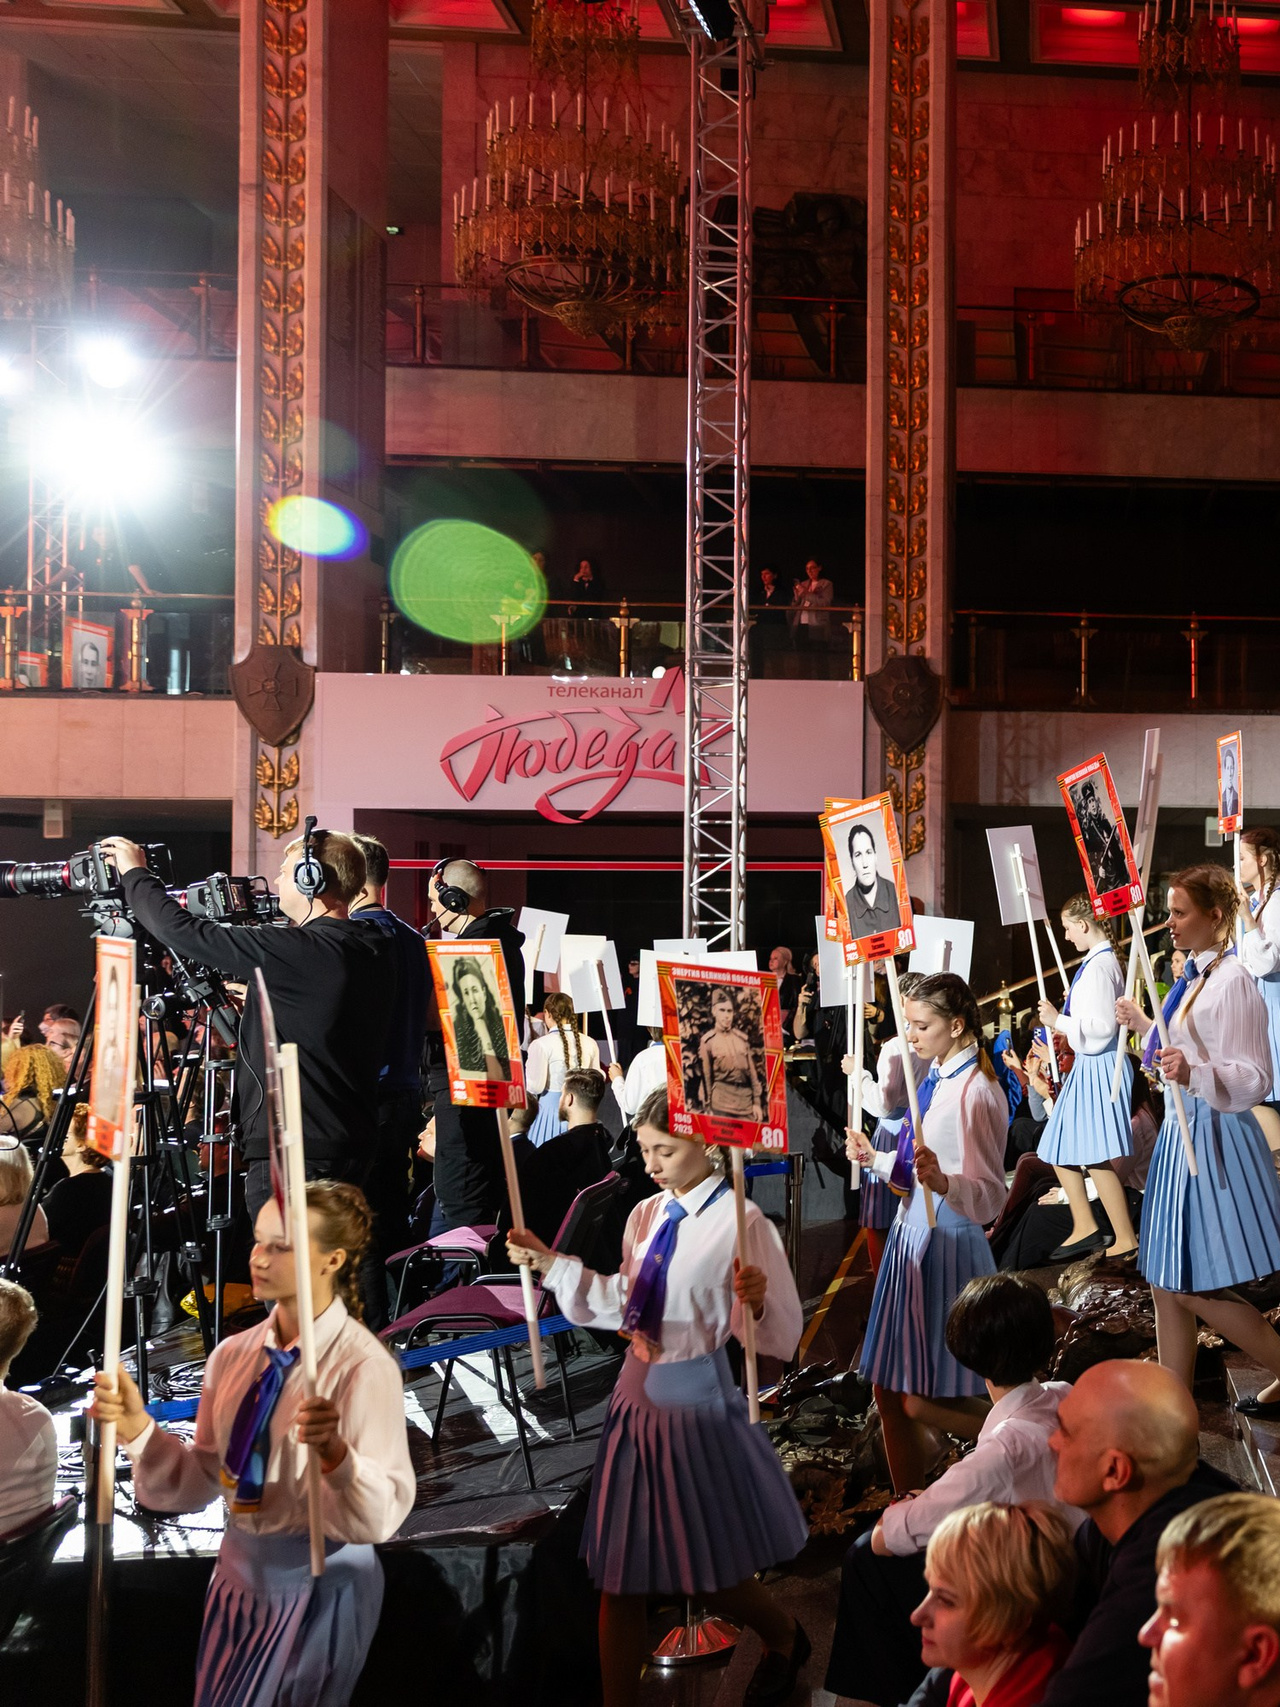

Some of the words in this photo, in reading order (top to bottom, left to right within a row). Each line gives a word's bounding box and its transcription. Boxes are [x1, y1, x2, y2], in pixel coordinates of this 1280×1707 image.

[547, 684, 643, 698] телеканал
[440, 704, 680, 824] Победа
[1130, 884, 1142, 904] 80
[897, 928, 913, 949] 80
[672, 967, 700, 977] ЭНЕРГИЯ
[701, 970, 731, 981] ВЕЛИКОЙ
[731, 975, 761, 985] ПОБЕДЫ
[508, 1085, 523, 1105] 80
[673, 1112, 692, 1124] 1945
[673, 1123, 693, 1135] 2025
[761, 1126, 784, 1148] 80
